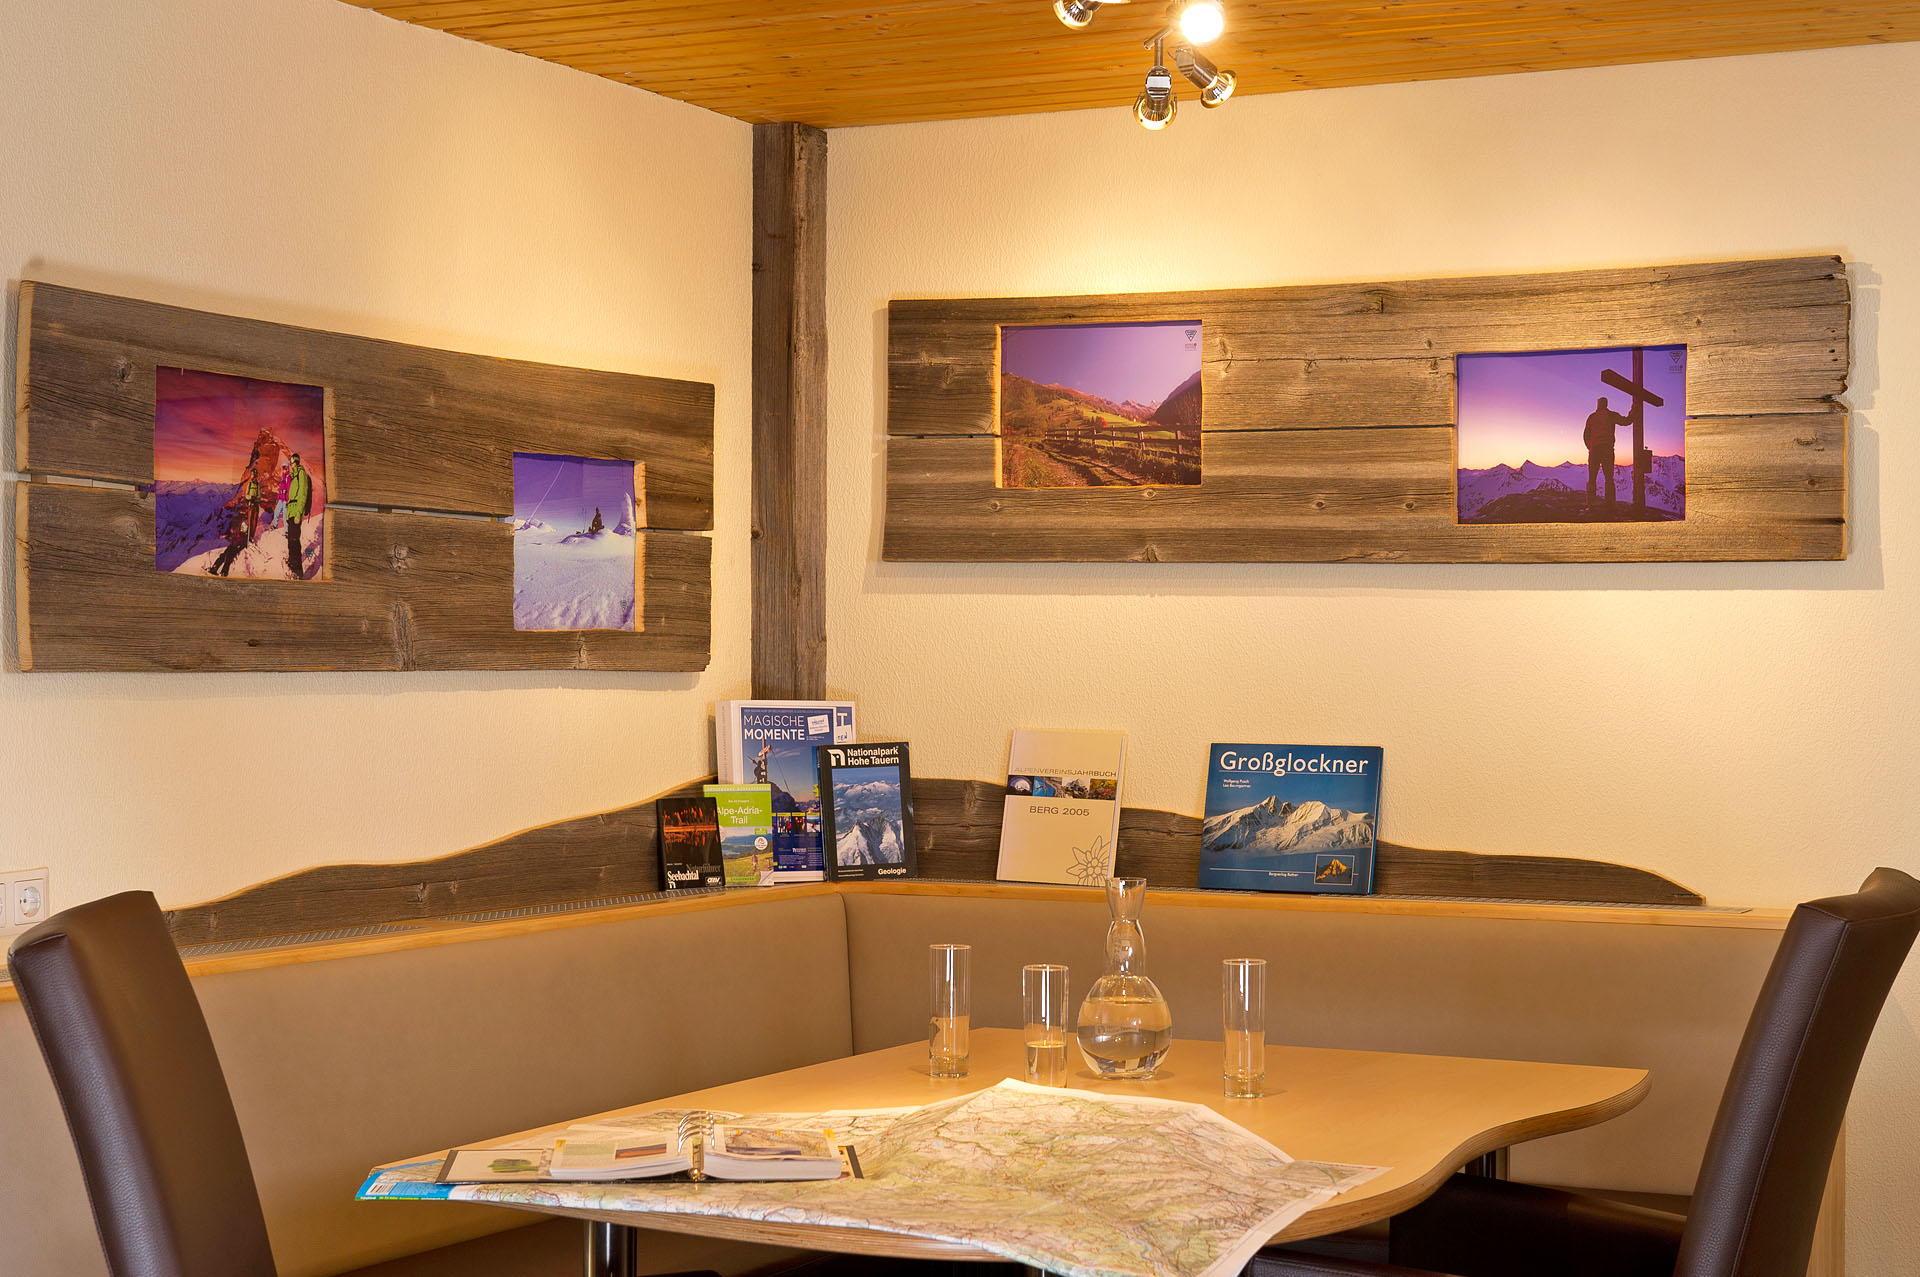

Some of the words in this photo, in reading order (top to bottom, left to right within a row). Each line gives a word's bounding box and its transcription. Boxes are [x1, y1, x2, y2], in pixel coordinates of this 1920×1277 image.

[743, 715, 805, 727] MAGISCHE
[744, 728, 806, 740] MOMENTE
[847, 746, 899, 757] Nationalpark
[847, 757, 870, 766] Hohe
[870, 756, 900, 765] Tauern
[1220, 751, 1369, 777] Großglockner
[1014, 767, 1117, 777] ALPENVEREINSJAHRBUCH
[717, 806, 763, 816] Alpe-Adria-
[1029, 805, 1059, 815] BERG
[1062, 807, 1090, 816] 2005
[730, 816, 749, 825] Trail
[877, 867, 907, 876] Geologie
